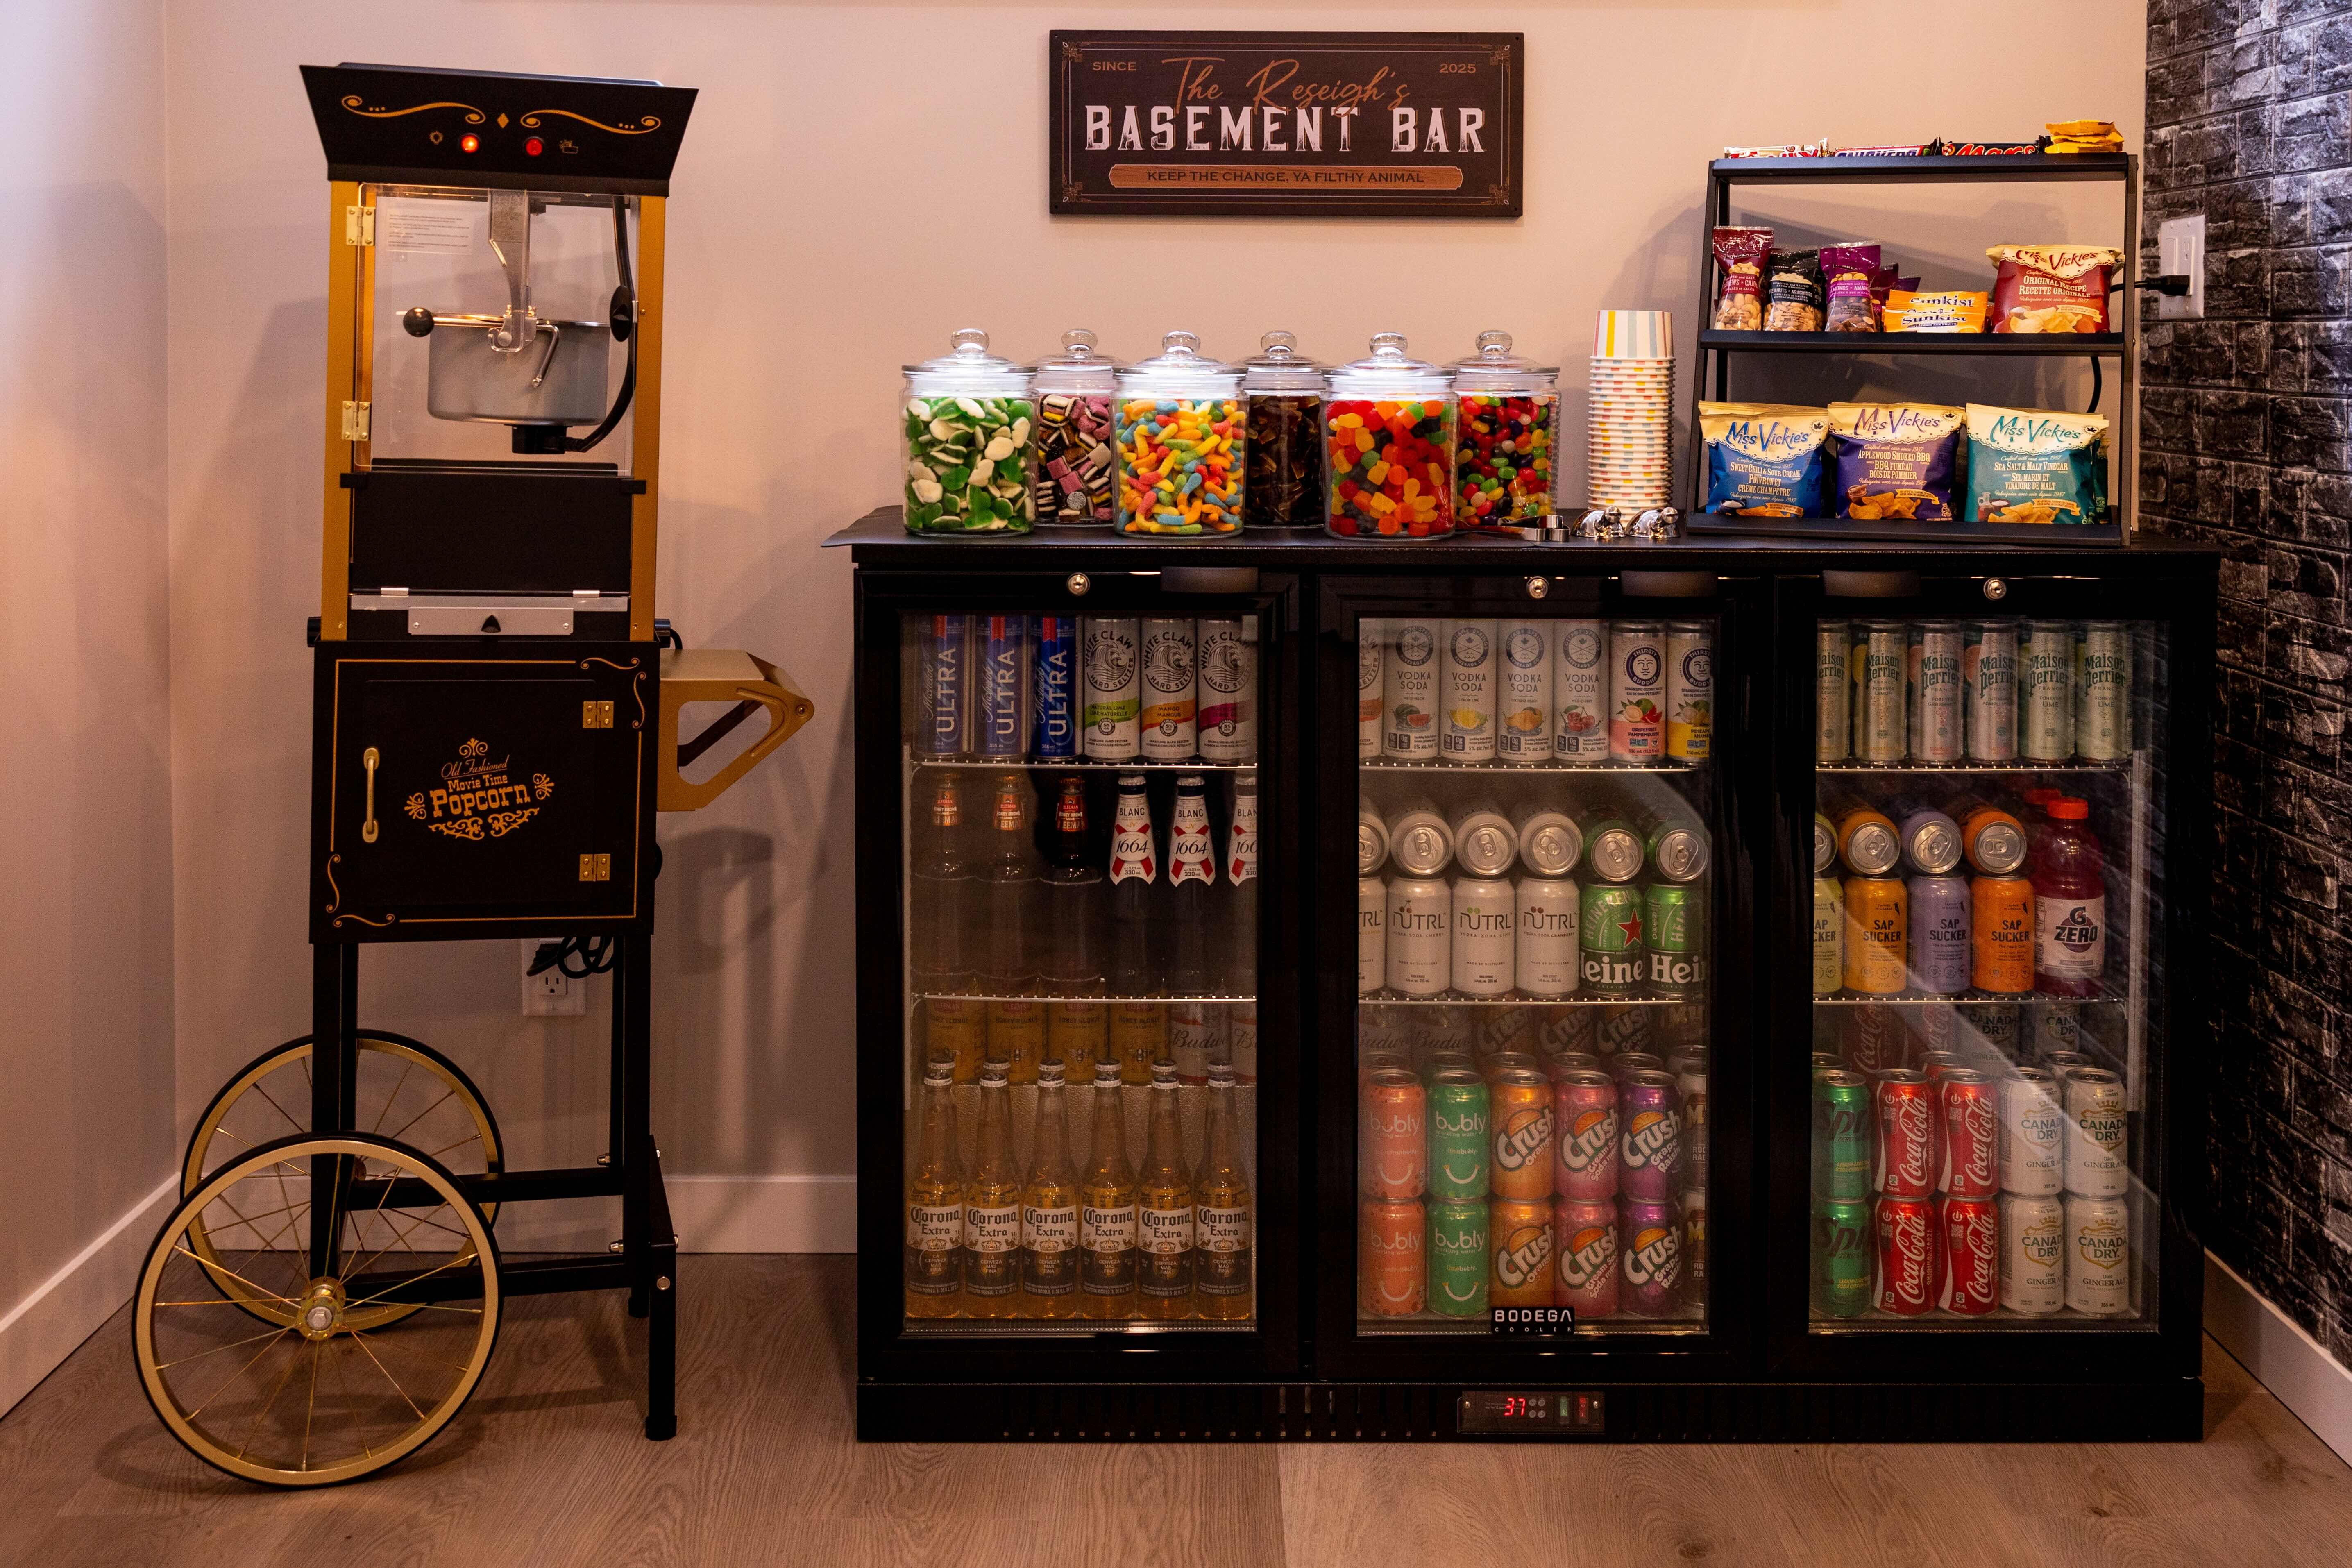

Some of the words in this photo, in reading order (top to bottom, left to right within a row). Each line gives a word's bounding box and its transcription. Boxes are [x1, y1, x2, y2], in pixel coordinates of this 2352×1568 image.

[1093, 61, 1136, 71] SINCE
[1439, 63, 1477, 73] 2025
[1162, 57, 1225, 115] The
[1245, 59, 1410, 118] Reseigh's
[1085, 105, 1360, 151] BASEMENT
[1391, 107, 1486, 152] BAR
[1148, 171, 1186, 182] KEEP
[1190, 171, 1219, 182] THE
[1222, 171, 1289, 183] CHANGE,
[1293, 172, 1311, 182] YA
[1315, 172, 1364, 182] FILTHY
[1368, 172, 1425, 182] ANIMAL
[2049, 252, 2098, 271] Vickie's
[2019, 285, 2052, 295] RECETTE
[2053, 288, 2091, 298] ORIGINALE
[2023, 275, 2059, 286] ORIGINAL
[2060, 280, 2087, 292] RECIPE
[1901, 315, 1967, 324] Sunkist
[1853, 407, 1887, 436] Miss
[1888, 408, 1941, 433] Vickie's
[1989, 415, 2025, 443] Miss
[2028, 419, 2081, 443] Vickie's
[1725, 421, 1758, 450] Miss
[1758, 421, 1810, 452] Vickie's
[1858, 449, 1892, 460] APPLEWOOD
[1892, 450, 1916, 461] SMOKED
[1916, 452, 1931, 463] BBQ
[1730, 461, 1748, 472] SWEET
[1749, 463, 1763, 474] CHILI
[1767, 468, 1782, 477] SOUR
[1874, 460, 1889, 470] BBQ
[1889, 461, 1906, 471] FUMÉ
[1906, 463, 1913, 471] AU
[1994, 461, 2005, 471] SEA
[2007, 461, 2021, 471] SALT
[2027, 461, 2043, 470] MALT
[2043, 461, 2068, 471] VINEGAR
[1749, 474, 1775, 485] POIVRON
[1774, 478, 1782, 486] ET
[1869, 470, 1884, 479] BOIS
[1883, 471, 1892, 479] DE
[1892, 471, 1917, 480] POMMIER
[2012, 473, 2023, 481] SEL
[2005, 482, 2032, 490] VINAIGRE
[2041, 482, 2056, 490] MALT
[1084, 634, 1099, 667] WHITE
[1101, 631, 1133, 649] CLAW
[1144, 635, 1160, 669] WHITE
[1162, 631, 1193, 649] CLAW
[1200, 635, 1218, 670] WHITE
[1632, 648, 1658, 656] THIRSTY
[1921, 655, 1960, 672] Maison
[2029, 654, 2069, 670] Maison
[2084, 654, 2125, 672] Maison
[1090, 674, 1109, 689] HARD
[1113, 657, 1134, 688] SELTZER
[1151, 676, 1172, 690] HARD
[1175, 658, 1194, 689] SELTZER
[1397, 671, 1431, 681] VODKA
[1452, 672, 1486, 682] VODKA
[1507, 673, 1542, 682] VODKA
[1565, 674, 1599, 683] VODKA
[1632, 676, 1658, 685] BUDDHA
[937, 646, 956, 733] ULTRA
[1208, 676, 1229, 690] HARD
[1400, 681, 1428, 690] SODA
[1455, 682, 1483, 692] SODA
[1510, 683, 1538, 692] SODA
[1568, 683, 1596, 692] SODA
[1921, 670, 1960, 699] perrier
[2084, 669, 2126, 697] perrier
[996, 648, 1015, 735] ULTRA
[1048, 649, 1067, 736] ULTRA
[440, 761, 462, 778] Old
[462, 754, 510, 776] Fashioned
[447, 777, 481, 792] Movie
[482, 774, 508, 787] Time
[429, 783, 532, 818] Popcorn
[1119, 807, 1145, 816] BLANC
[1178, 809, 1204, 818] BLANC
[1116, 838, 1150, 853] 1664
[1175, 840, 1208, 855] 1664
[1584, 890, 1631, 940] HEINEKEN
[2069, 906, 2087, 926] G
[1874, 919, 1894, 930] SAP
[1940, 919, 1960, 929] SAP
[2002, 920, 2022, 930] SAP
[1863, 930, 1901, 942] SUCKER
[1930, 930, 1966, 942] SUCKER
[1991, 930, 2030, 942] SUCKER
[2053, 925, 2098, 944] ZERO
[1969, 1013, 2019, 1025] CANADA
[1435, 1111, 1486, 1134] bubly
[1497, 1107, 1554, 1168] Crush
[1562, 1108, 1619, 1168] Crush
[1622, 1110, 1680, 1167] Crush
[1899, 1089, 1928, 1187] Coca-Cola
[1965, 1090, 1994, 1187] Coca-Cola
[2084, 1161, 2115, 1169] GINGER
[910, 1206, 962, 1227] Corona
[967, 1207, 1019, 1229] Corona
[1025, 1207, 1076, 1229] Corona
[1083, 1208, 1135, 1228] Corona
[1141, 1209, 1192, 1229] Corona
[1198, 1208, 1248, 1227] Corona
[921, 1223, 950, 1236] Extra
[979, 1225, 1008, 1237] Extra
[1036, 1225, 1065, 1237] Extra
[1095, 1225, 1124, 1237] Extra
[1153, 1228, 1182, 1239] Extra
[1209, 1225, 1238, 1237] Extra
[1435, 1227, 1486, 1253] bubly
[1561, 1225, 1619, 1286] Crush
[1624, 1225, 1681, 1284] Crush
[1895, 1208, 1926, 1305] Coca-Cola
[1966, 1207, 1995, 1303] Coca-Cola
[2082, 1278, 2114, 1286] GINGER
[1495, 1309, 1572, 1323] BODEGA
[1504, 1397, 1526, 1416] 37
